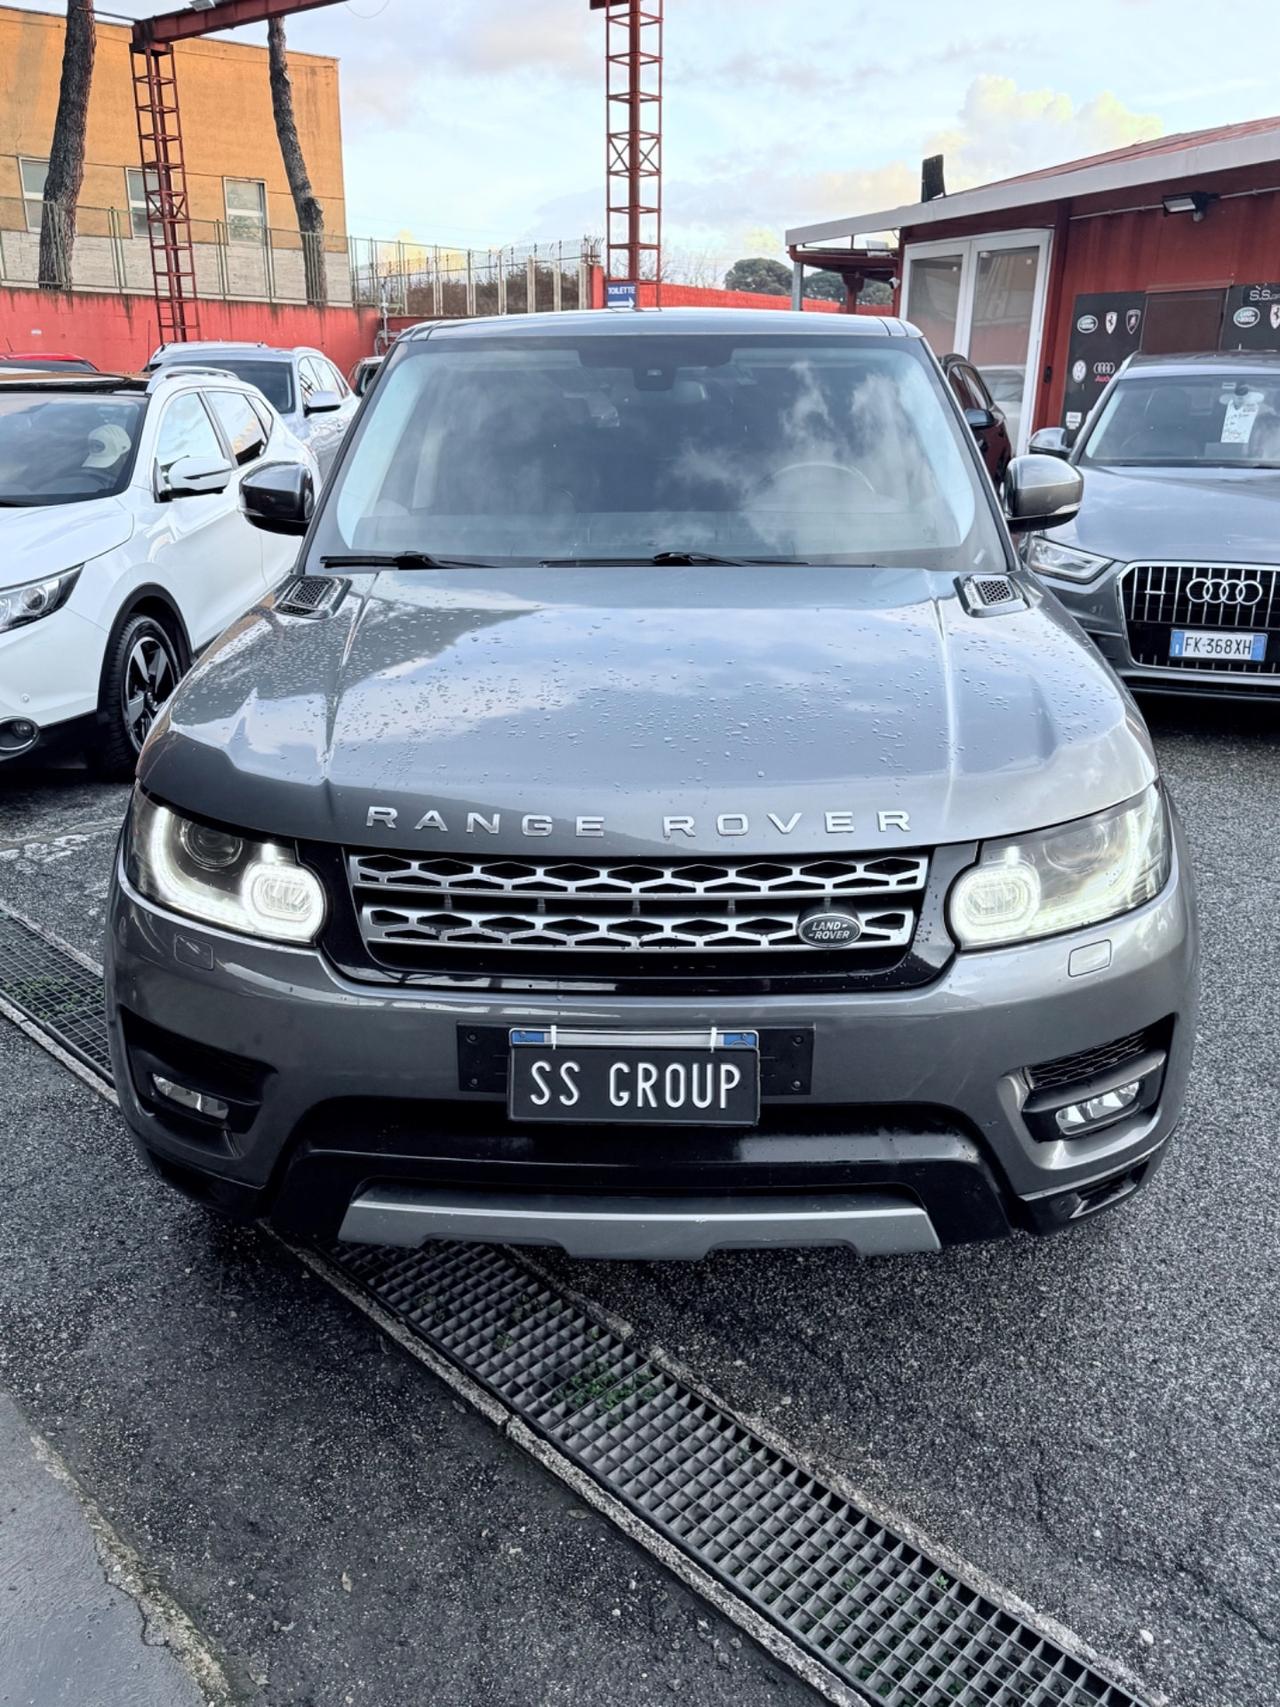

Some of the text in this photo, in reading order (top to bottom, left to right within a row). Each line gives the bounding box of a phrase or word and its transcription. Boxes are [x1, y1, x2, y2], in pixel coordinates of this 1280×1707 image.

[608, 286, 636, 295] TOILETTE
[1094, 374, 1110, 383] Aud
[365, 805, 912, 838] RANGE ROVER
[530, 1060, 742, 1110] SS GROUP
